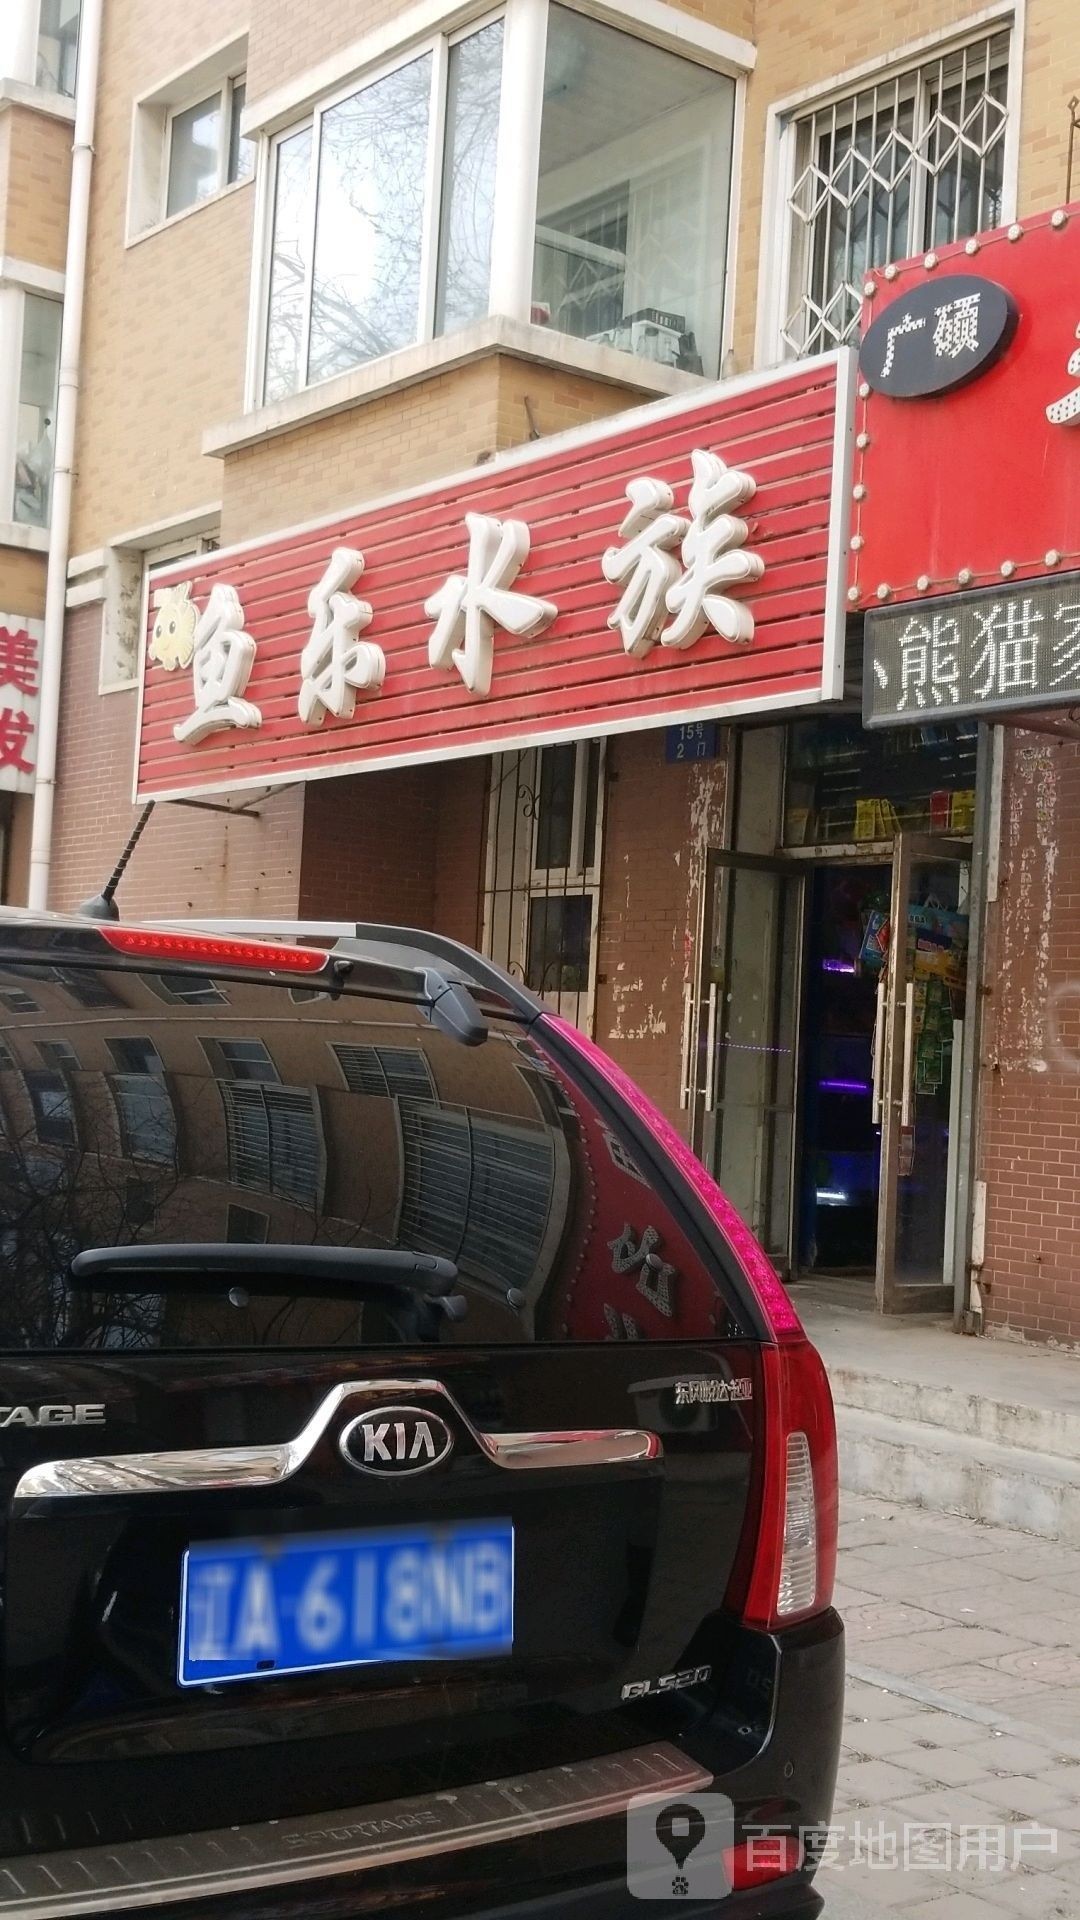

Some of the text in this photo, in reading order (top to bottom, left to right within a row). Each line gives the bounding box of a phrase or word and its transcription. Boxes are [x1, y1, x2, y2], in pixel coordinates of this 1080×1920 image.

[172, 448, 766, 745] 鱼乐水族
[873, 599, 1080, 711] 熊猫
[679, 722, 704, 740] 15号
[362, 1421, 436, 1462] KIA
